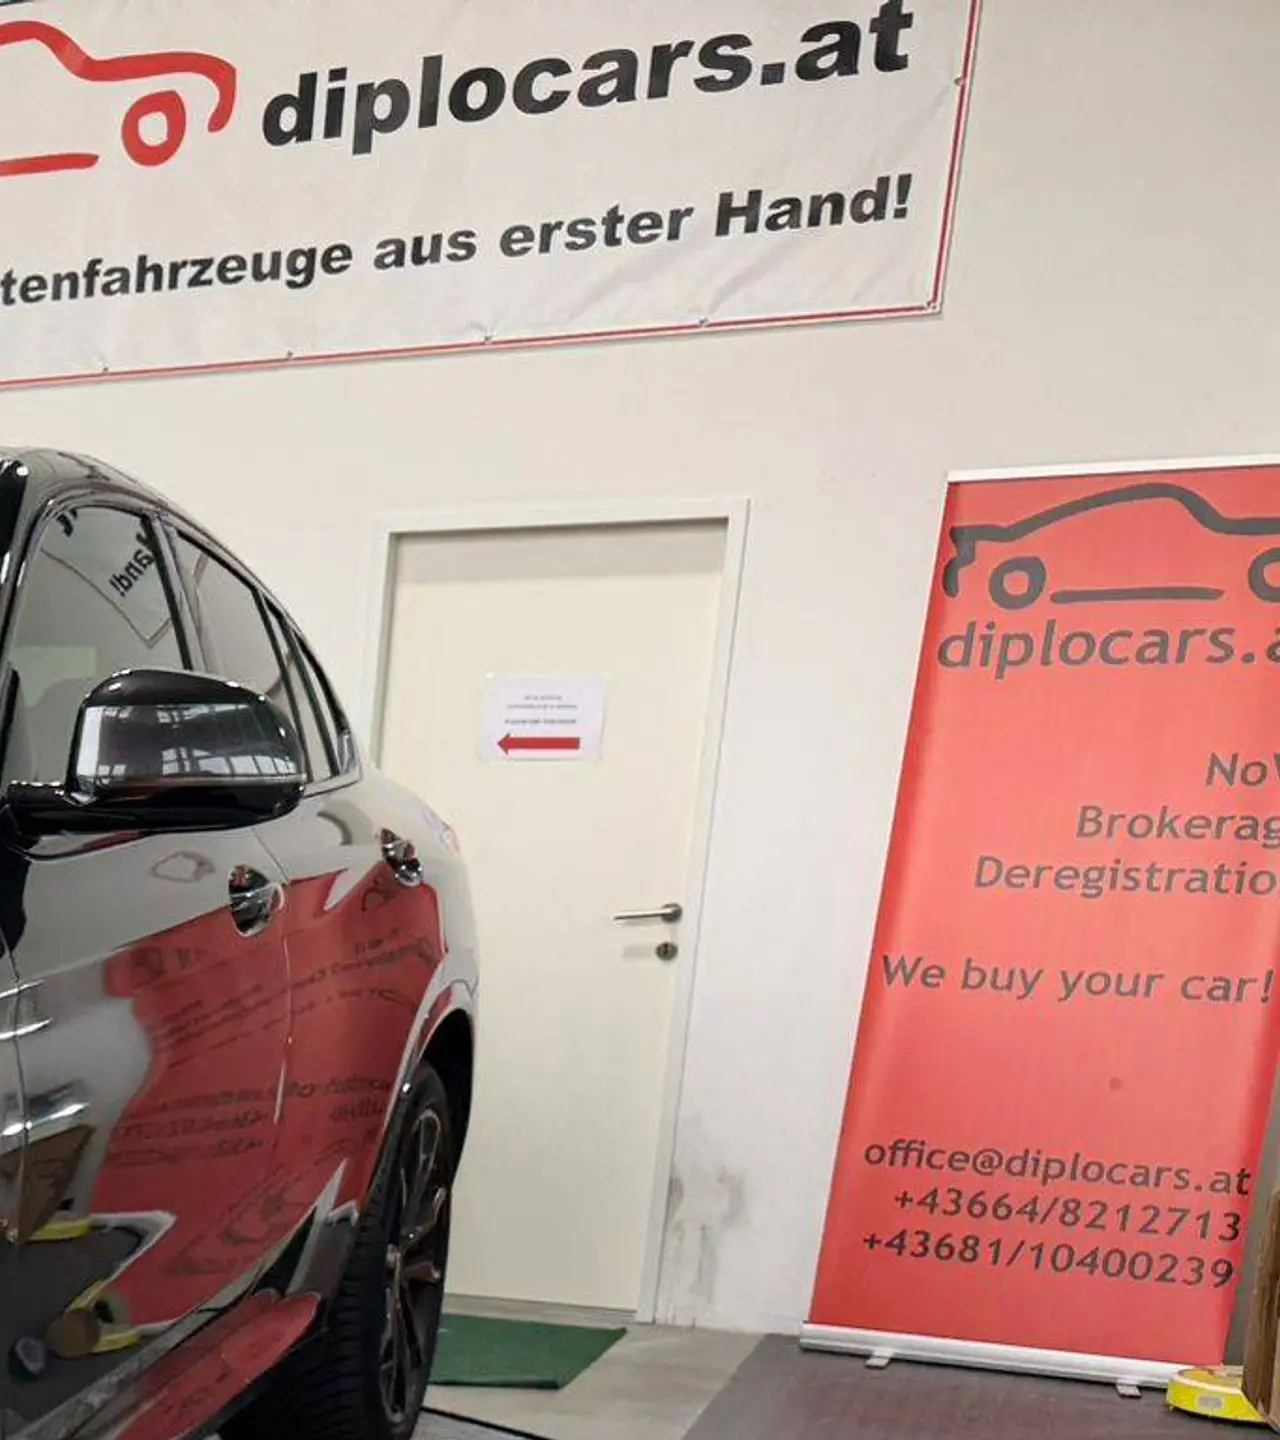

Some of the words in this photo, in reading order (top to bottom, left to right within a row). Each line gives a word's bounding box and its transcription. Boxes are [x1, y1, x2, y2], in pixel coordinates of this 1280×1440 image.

[261, 0, 915, 156] diplocars.at
[374, 229, 477, 270] aus
[499, 204, 694, 258] erster
[715, 172, 913, 237] Hand!
[883, 954, 946, 989] We
[961, 958, 1044, 1000] buy
[1058, 970, 1163, 1001] your
[1180, 969, 1274, 1004] car!
[863, 1138, 1253, 1197] office@diplocars.at
[894, 1188, 1242, 1243] +43664/8212713
[863, 1230, 1234, 1288] +43681/10400239
